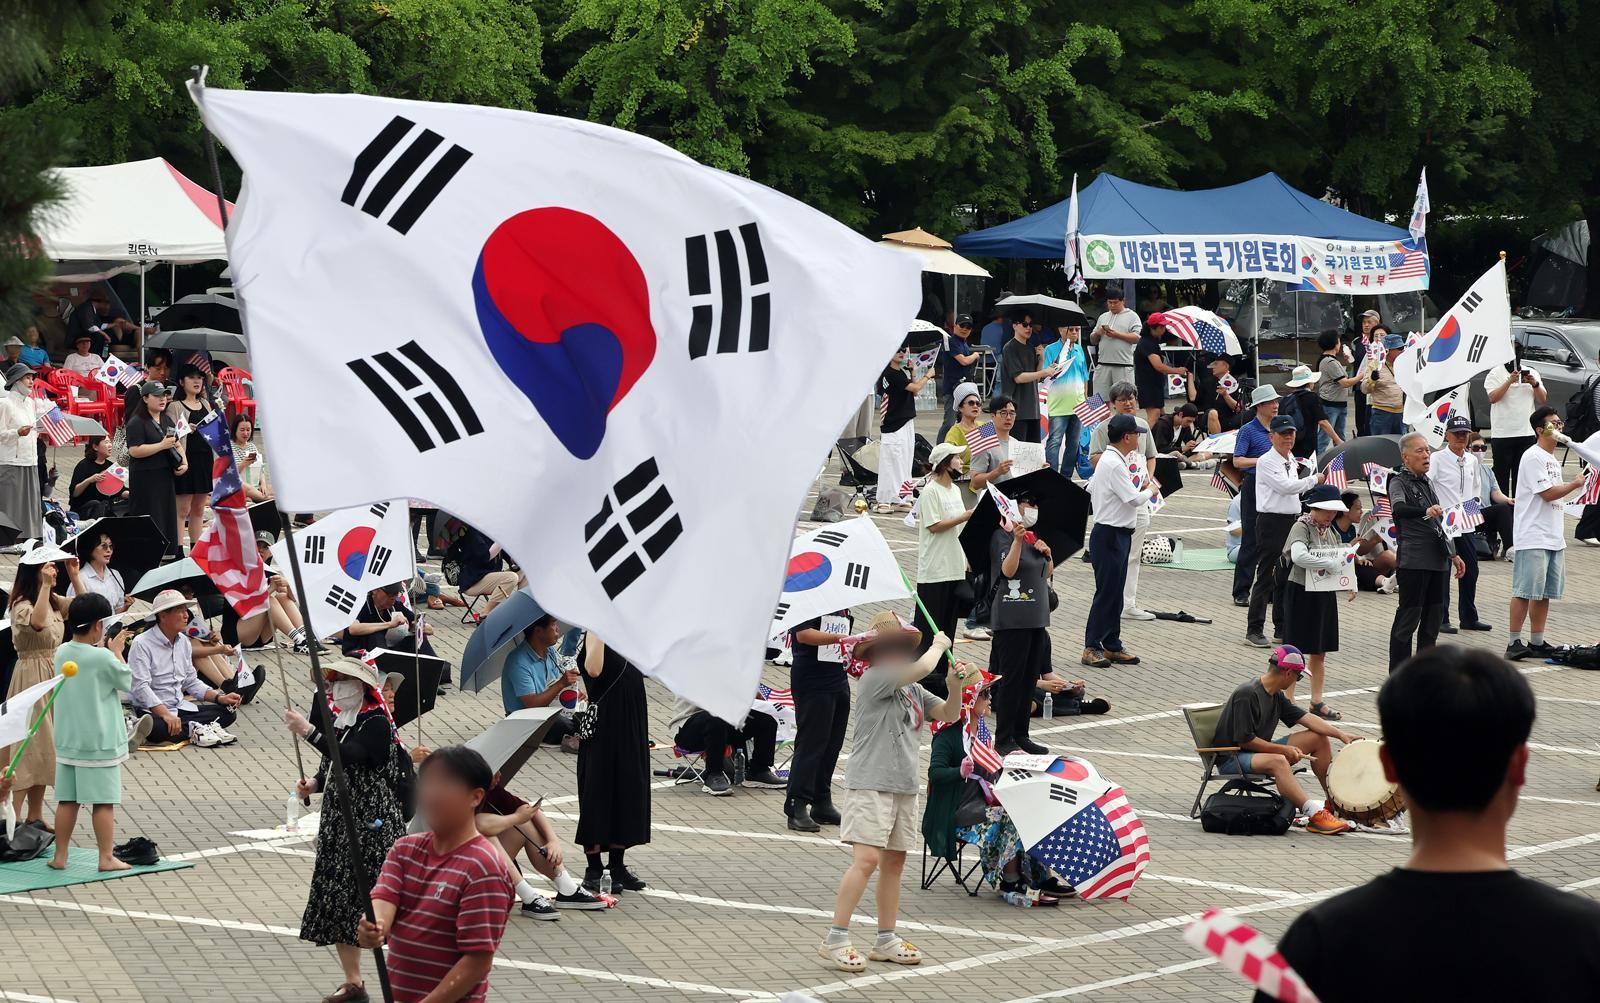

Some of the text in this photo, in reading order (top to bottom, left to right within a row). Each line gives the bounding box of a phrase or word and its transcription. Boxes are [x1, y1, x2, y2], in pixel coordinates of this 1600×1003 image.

[1119, 241, 1199, 274] 대한민국
[1204, 240, 1297, 275] 국가원로회
[1325, 254, 1387, 271] 국가원로회
